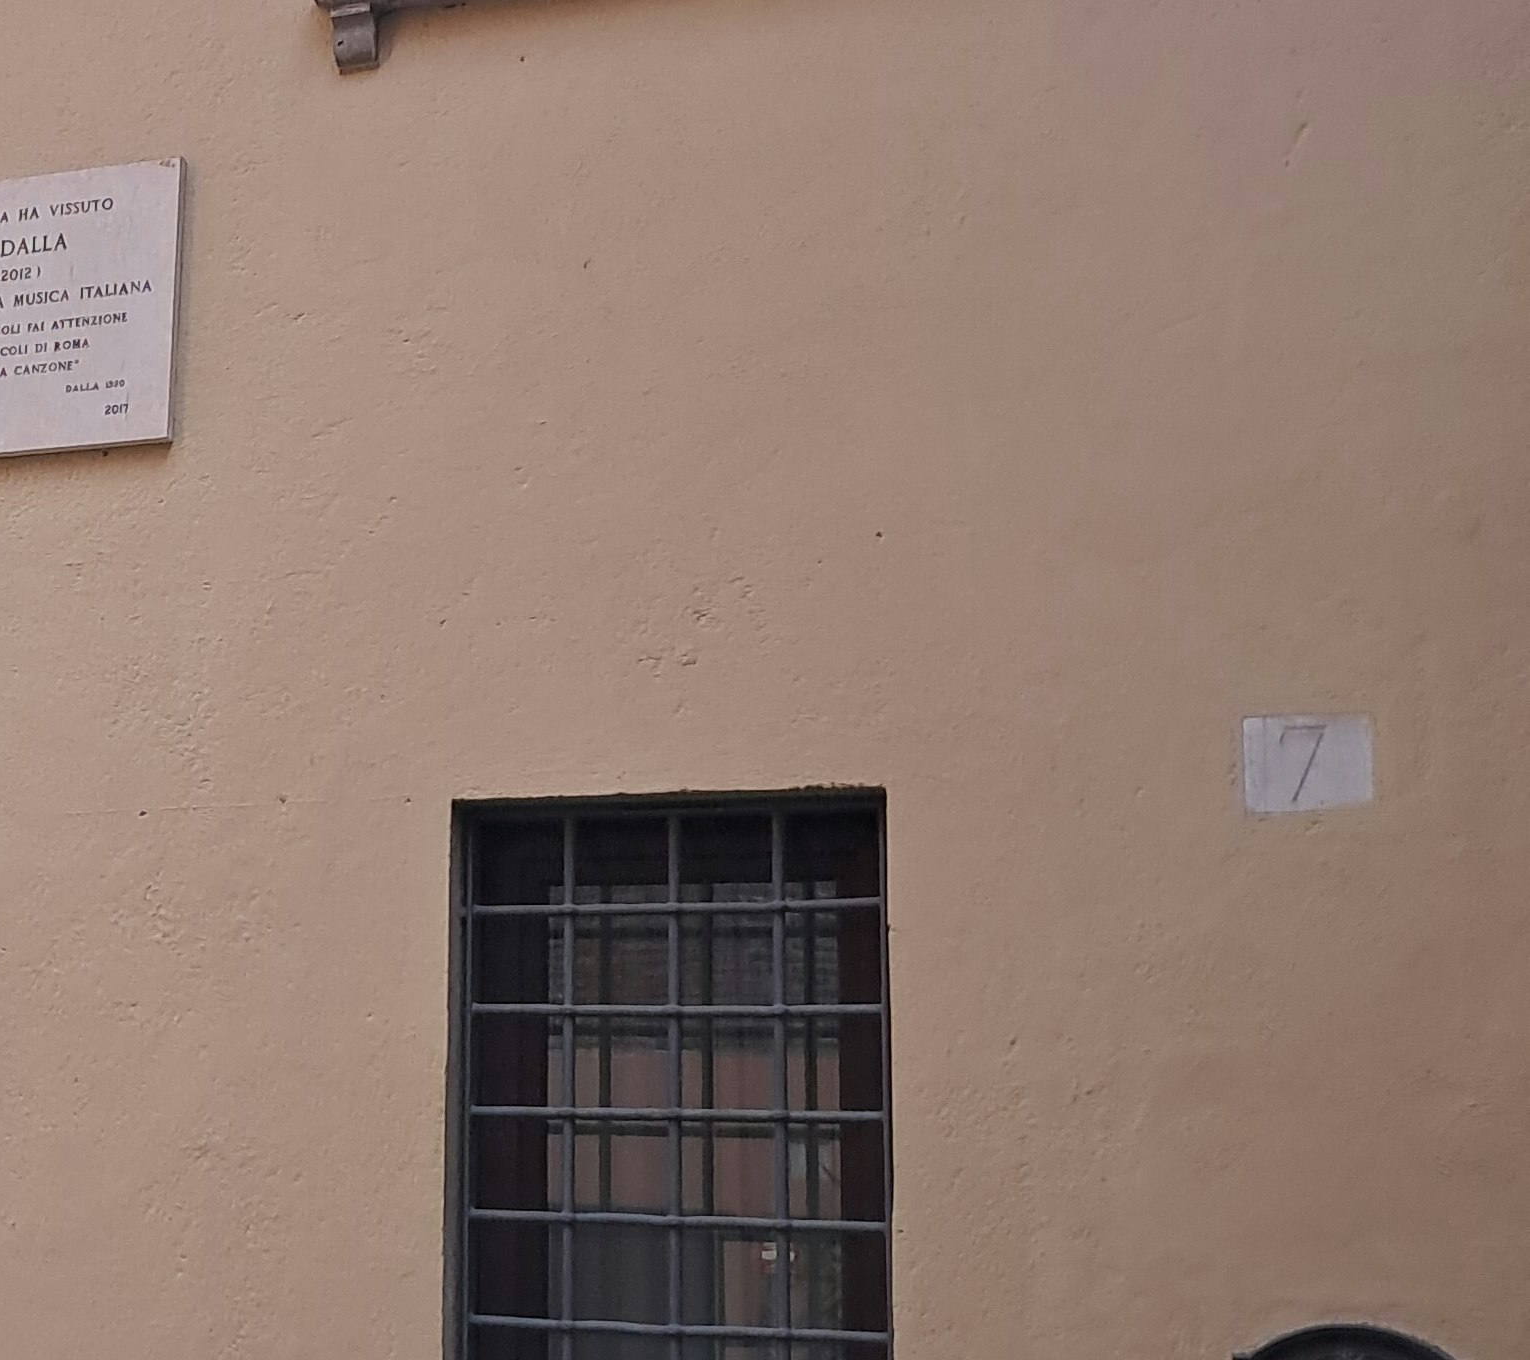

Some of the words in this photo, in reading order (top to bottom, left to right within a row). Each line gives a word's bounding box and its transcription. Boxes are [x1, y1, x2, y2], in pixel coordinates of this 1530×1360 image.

[18, 206, 40, 222] HA
[49, 197, 114, 217] VISSUTO
[0, 232, 67, 257] DALLA
[13, 289, 69, 307] MUSICA
[79, 279, 152, 300] ITALIANA
[27, 321, 45, 333] FAI
[51, 312, 128, 330] ATTENZIONE
[35, 342, 47, 353] DI
[54, 338, 90, 352] ROMA
[65, 382, 99, 393] DALLA
[104, 403, 129, 415] 2017
[1279, 724, 1327, 802] 7
